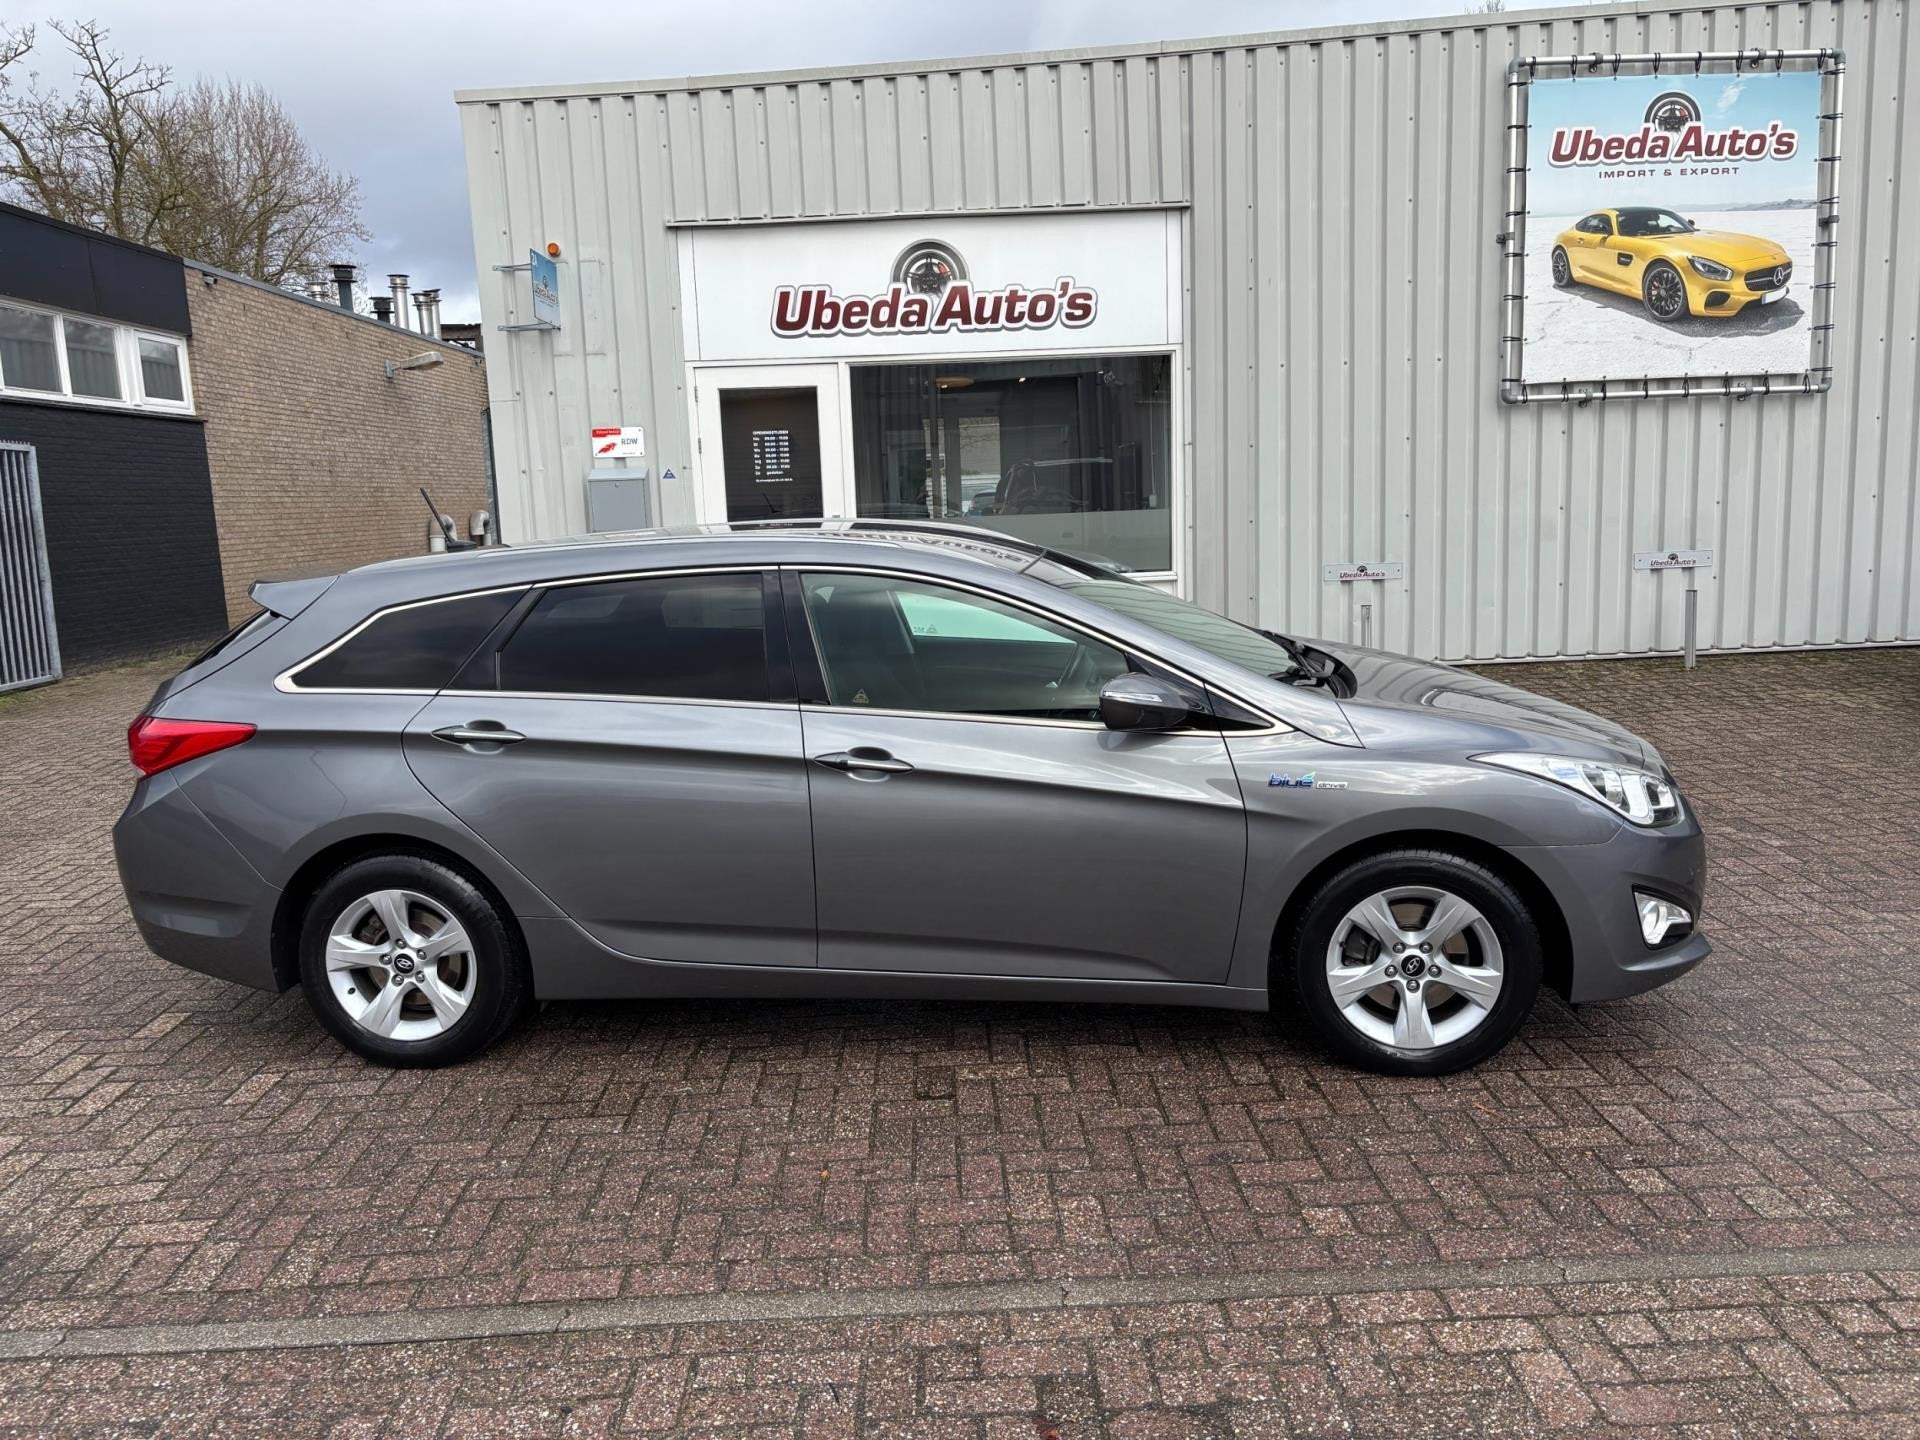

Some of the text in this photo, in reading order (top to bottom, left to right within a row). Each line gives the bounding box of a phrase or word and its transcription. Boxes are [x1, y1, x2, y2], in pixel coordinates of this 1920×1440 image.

[1551, 123, 1796, 163] Ubeda Auto's
[1598, 167, 1740, 179] IMPORT & EXPORT
[775, 281, 1093, 331] Ubeda Auto's
[1268, 773, 1314, 788] blue
